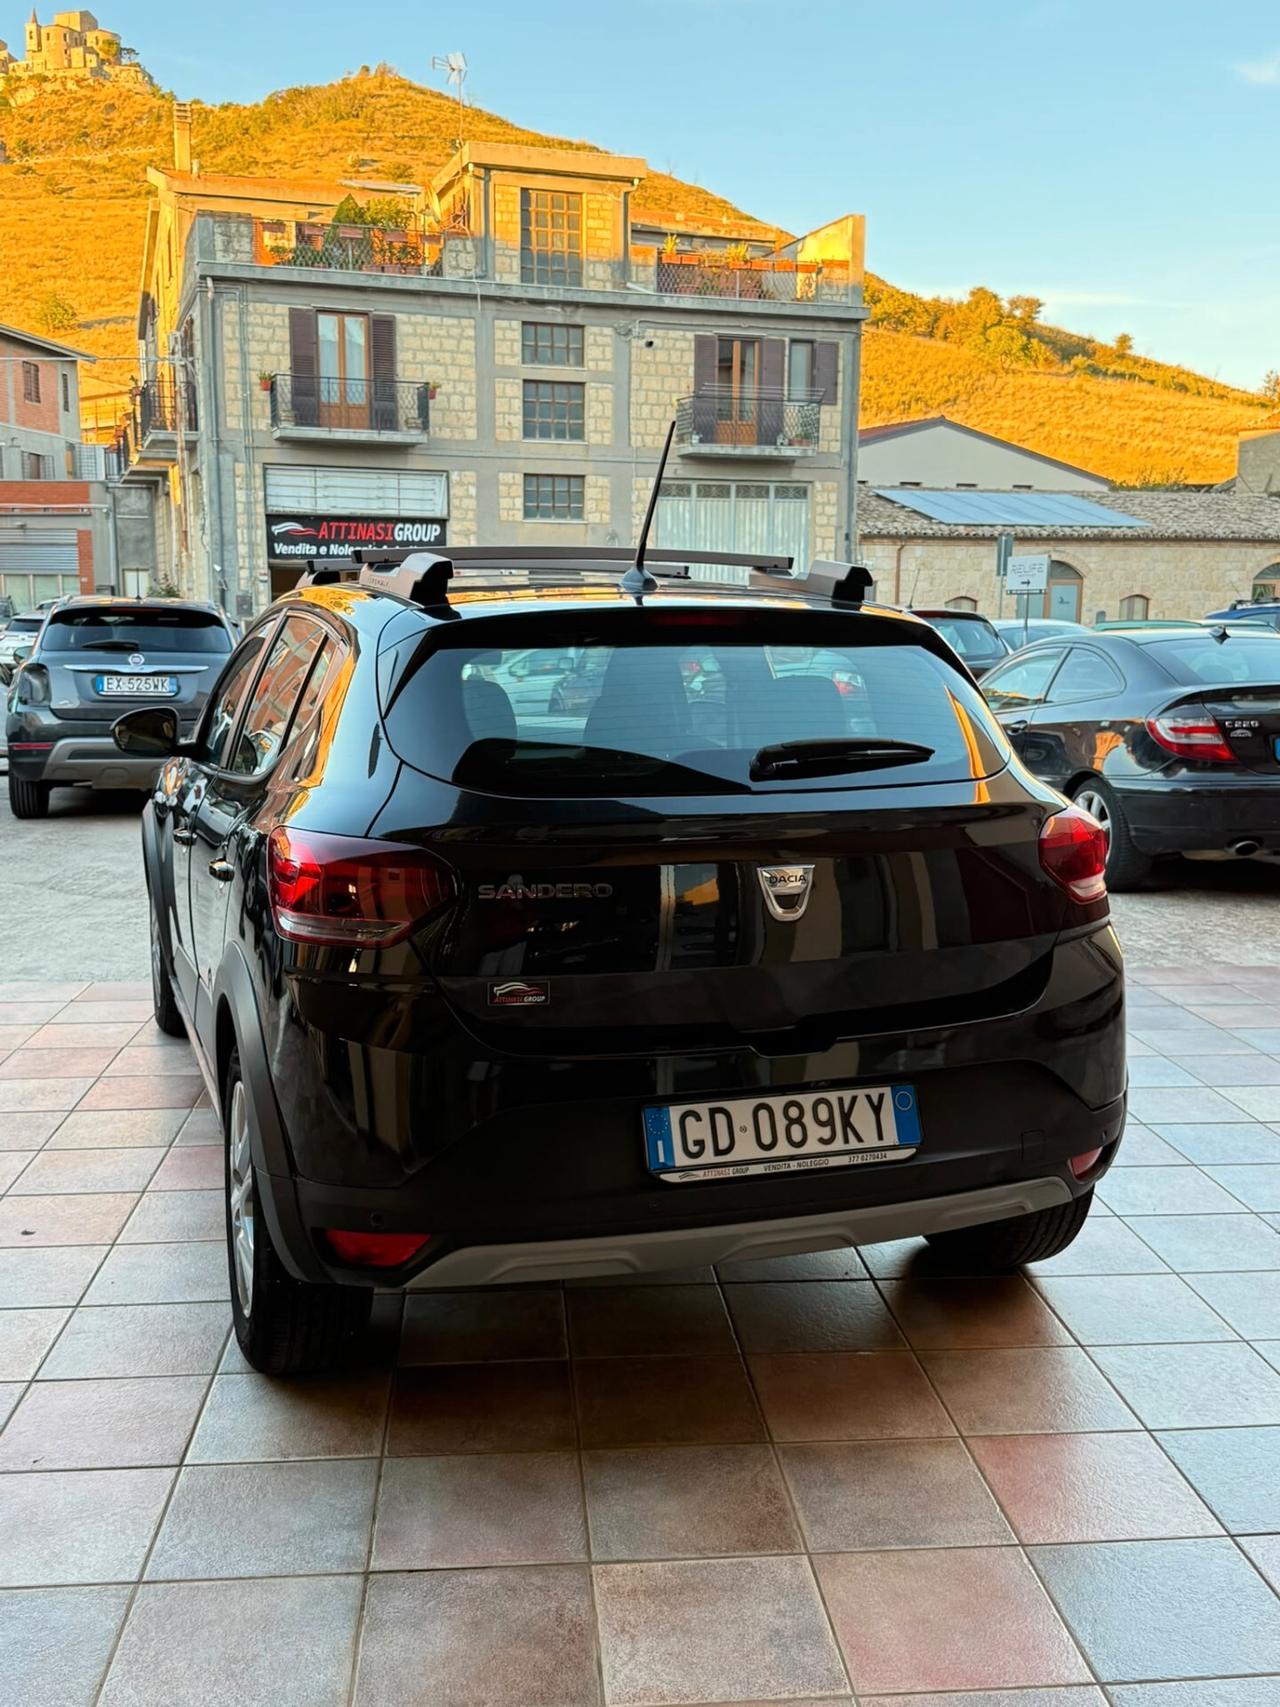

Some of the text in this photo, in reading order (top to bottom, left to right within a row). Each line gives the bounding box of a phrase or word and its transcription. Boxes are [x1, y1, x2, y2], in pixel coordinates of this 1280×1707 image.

[274, 543, 317, 555] Vendita
[319, 546, 327, 555] e
[769, 874, 807, 884] DACIA
[477, 883, 613, 900] SANDERO
[523, 995, 546, 1003] GROUP
[763, 1162, 791, 1172] VENDITA
[796, 1158, 829, 1169] NOLEGGIO
[732, 1167, 750, 1176] GROUP
